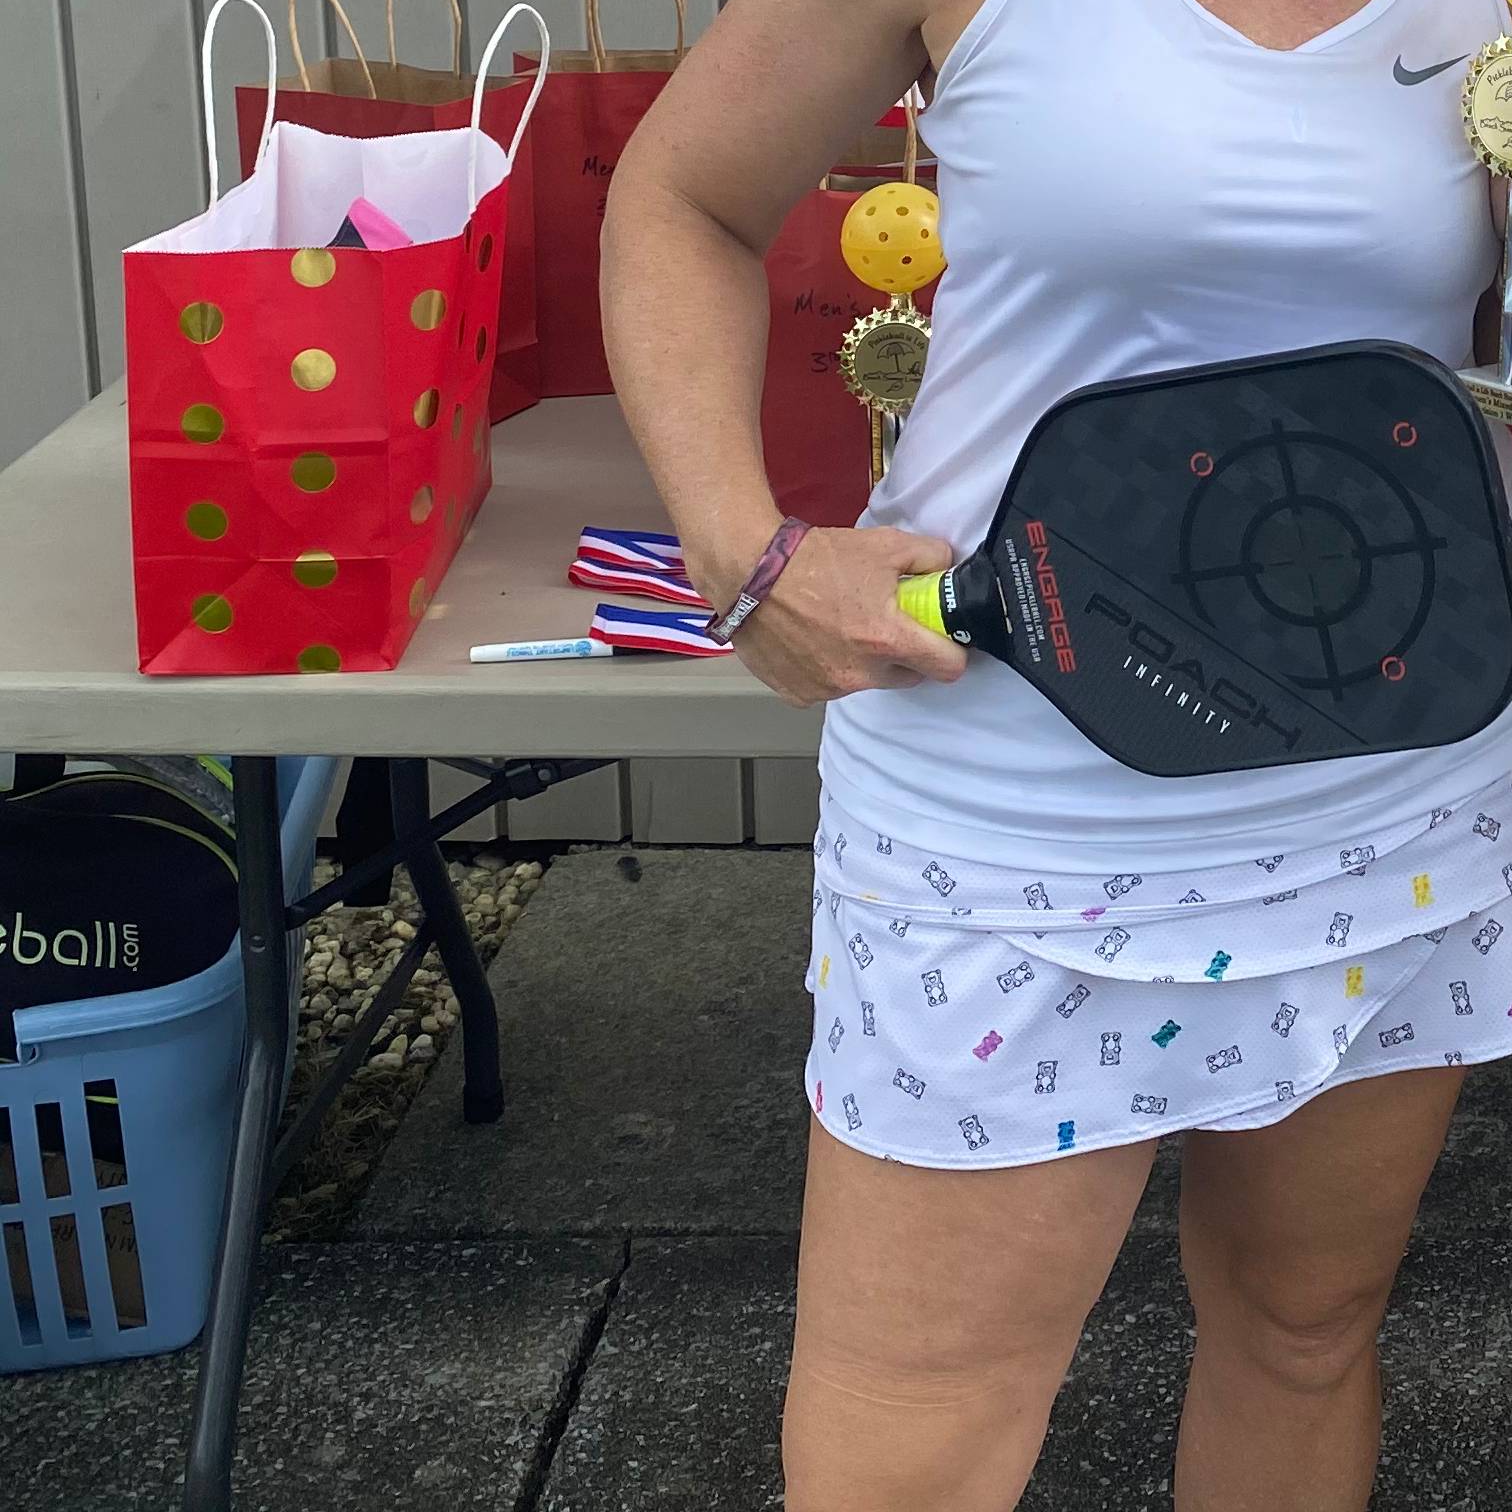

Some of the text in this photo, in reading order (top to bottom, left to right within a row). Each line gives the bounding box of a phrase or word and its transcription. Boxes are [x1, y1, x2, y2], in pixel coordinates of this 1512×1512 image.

[1025, 520, 1077, 673] ENGAGE
[1084, 593, 1302, 752] POACH
[1122, 655, 1230, 734] INFINITY
